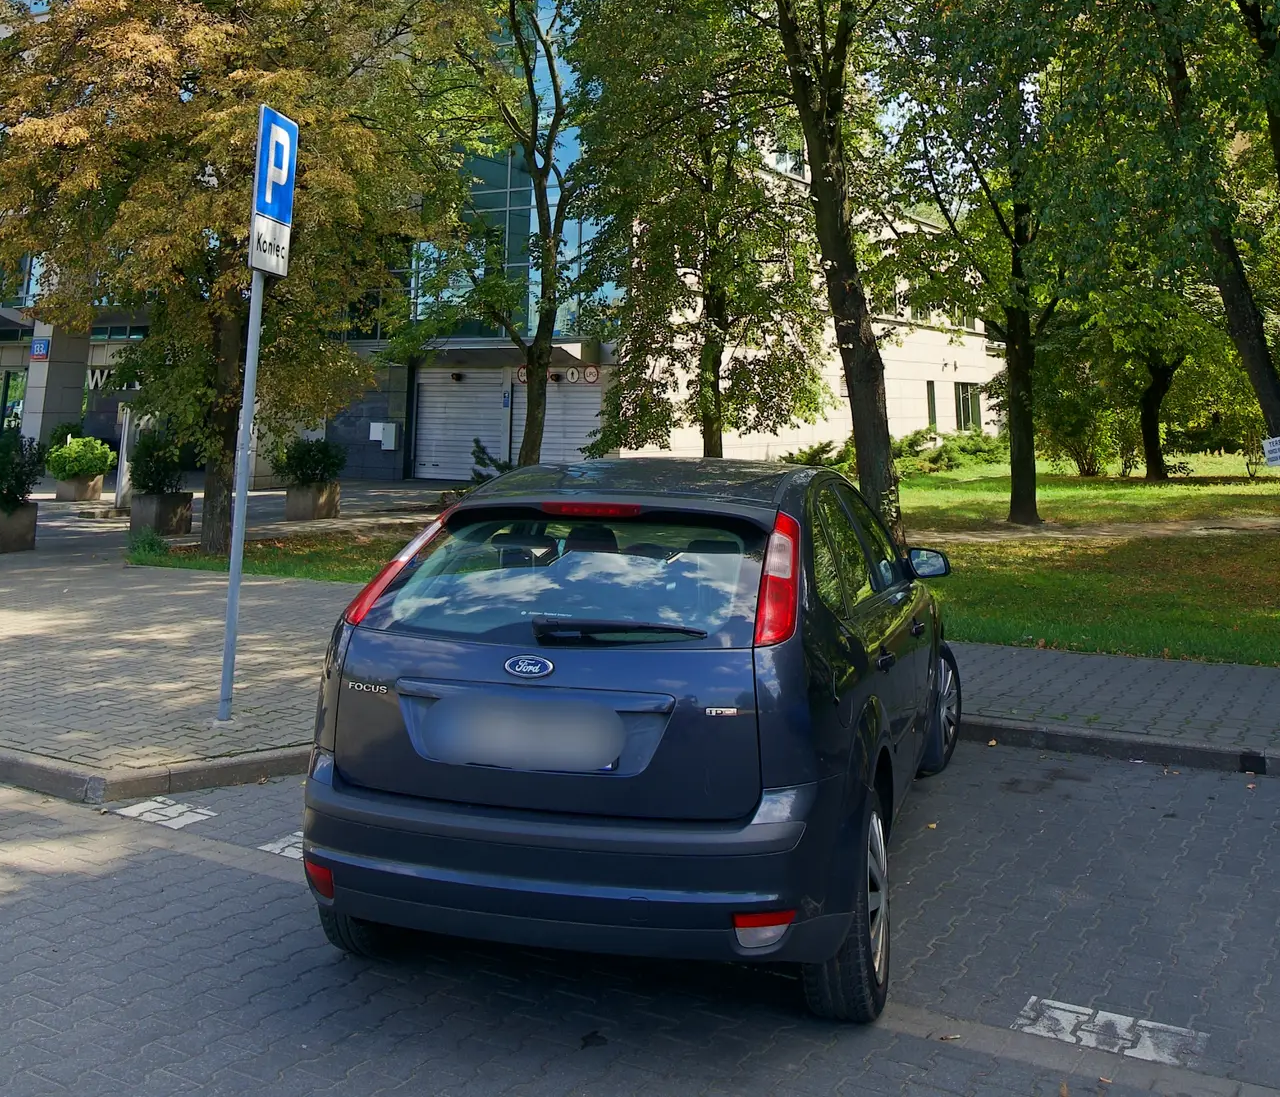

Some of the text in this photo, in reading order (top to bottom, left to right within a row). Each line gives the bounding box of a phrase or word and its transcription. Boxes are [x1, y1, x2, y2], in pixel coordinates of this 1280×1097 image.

[265, 123, 290, 203] P
[256, 231, 286, 260] Koniec
[585, 370, 597, 378] LPG
[515, 659, 541, 673] Ford
[348, 681, 388, 694] FOCUS
